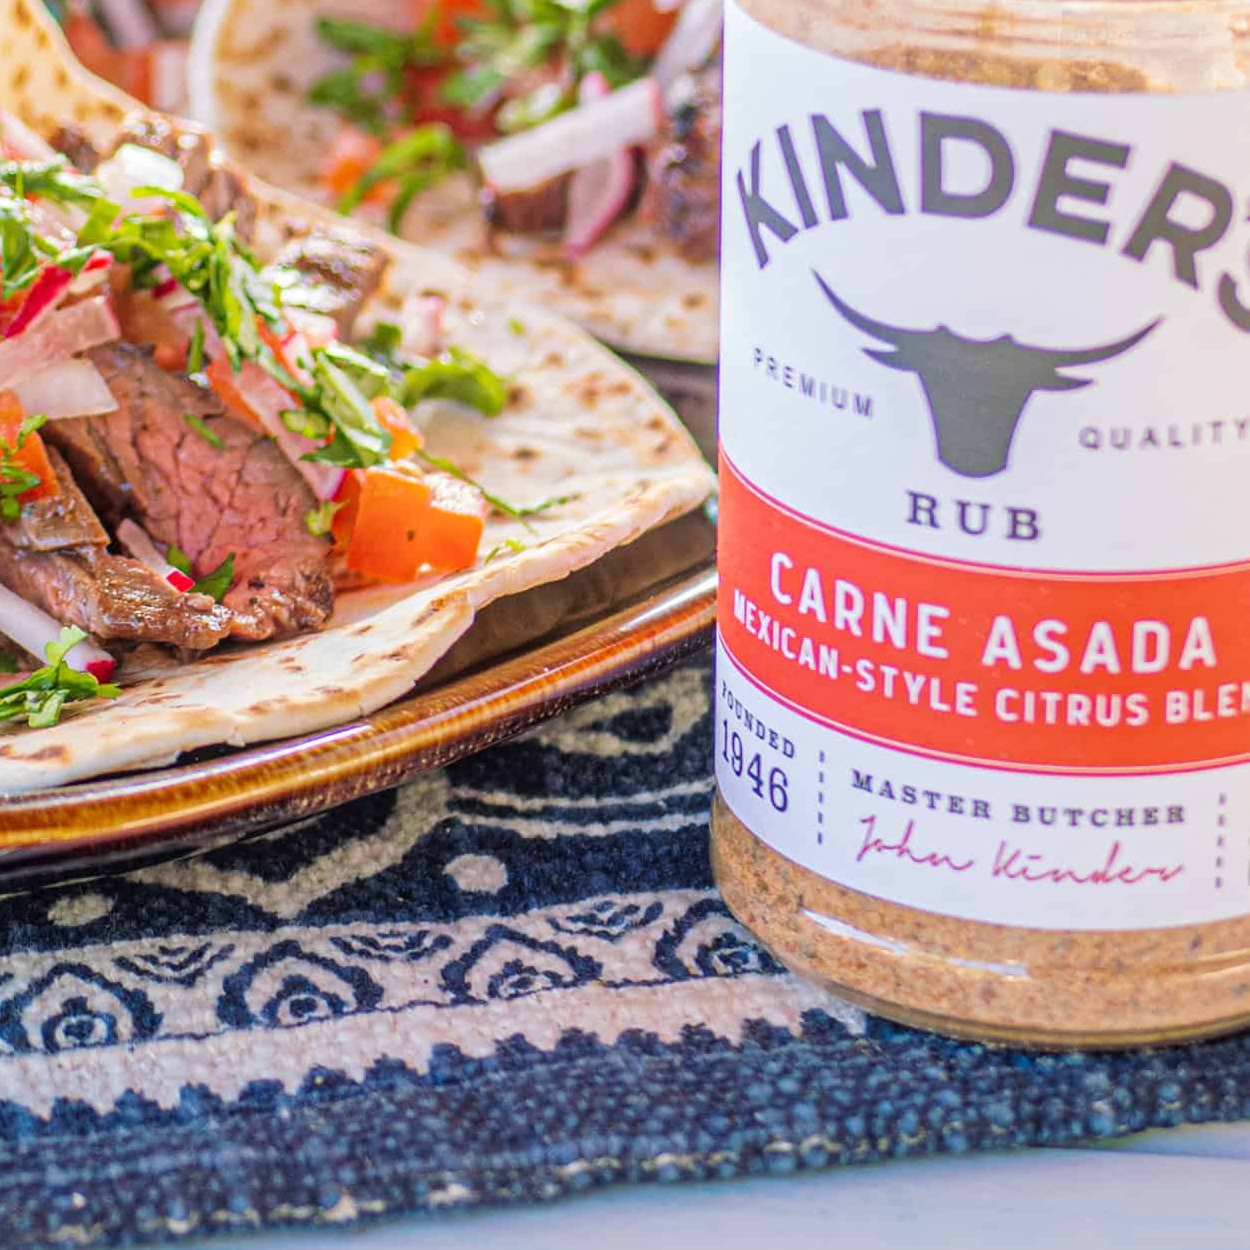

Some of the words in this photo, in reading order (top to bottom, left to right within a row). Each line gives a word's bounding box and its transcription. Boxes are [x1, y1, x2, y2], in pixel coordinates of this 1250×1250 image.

[753, 347, 873, 418] PREMIUM
[1079, 418, 1250, 451] QUALITY
[906, 489, 1042, 541] RUB
[769, 551, 951, 659] CARNE
[981, 615, 1217, 675] ASADA
[733, 588, 978, 717] MEXICAN-STYLE
[995, 688, 1149, 727] CITRUS
[722, 679, 796, 759] FOUNDED
[722, 718, 789, 813] 1946
[851, 768, 992, 819] MASTER
[1011, 804, 1185, 827] BUTCHER
[856, 814, 974, 871] John
